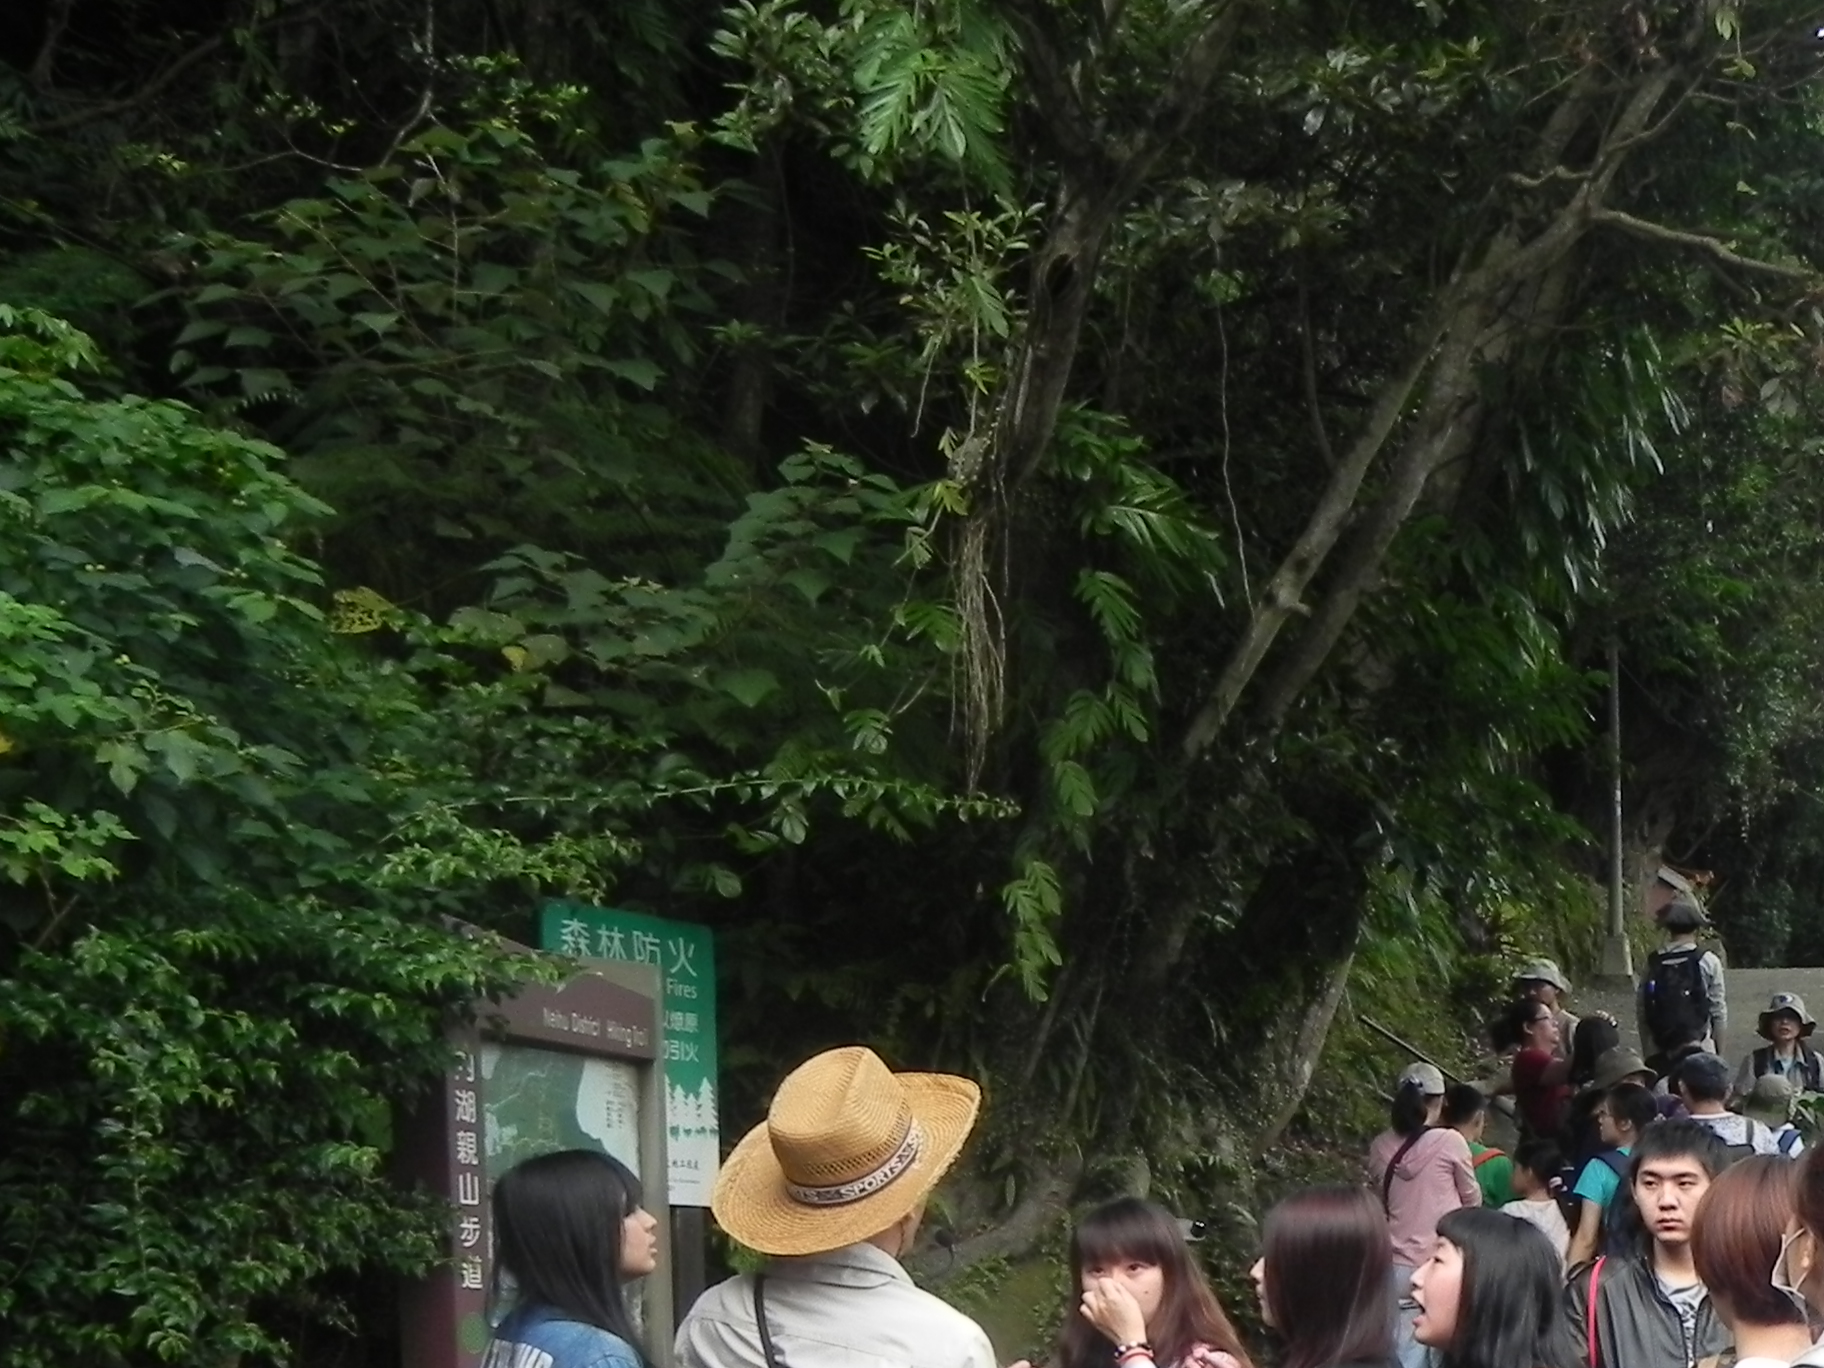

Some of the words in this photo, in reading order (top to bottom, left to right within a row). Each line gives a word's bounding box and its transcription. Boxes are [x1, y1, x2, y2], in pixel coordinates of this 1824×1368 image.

[561, 918, 698, 977] 森林防火
[666, 977, 698, 999] Fires
